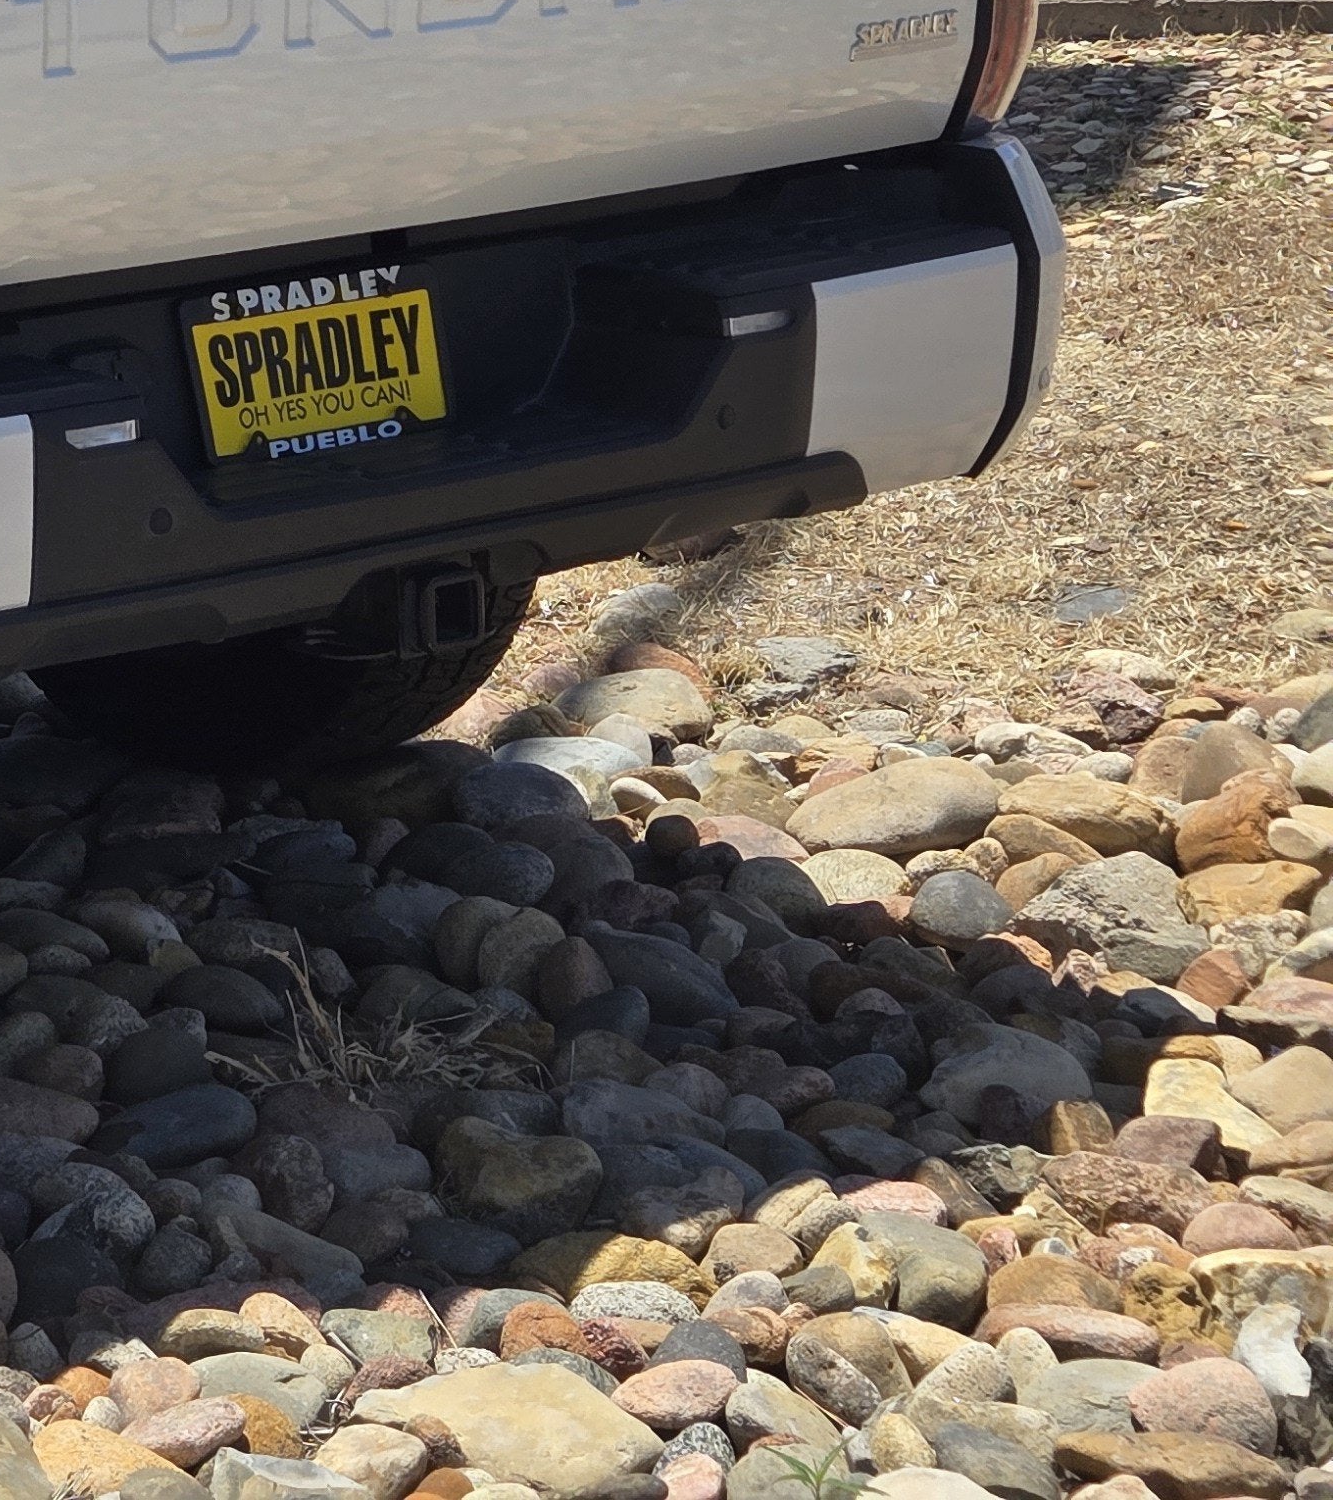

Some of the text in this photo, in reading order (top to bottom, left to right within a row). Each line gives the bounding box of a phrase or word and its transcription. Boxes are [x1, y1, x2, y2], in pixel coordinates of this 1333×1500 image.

[855, 8, 959, 47] SPRADLEY
[210, 265, 401, 322] SPRADLEY
[207, 303, 421, 409] SPRADLEY
[238, 379, 412, 429] OH YES YOU CAN!
[268, 419, 403, 459] PUEBLO
